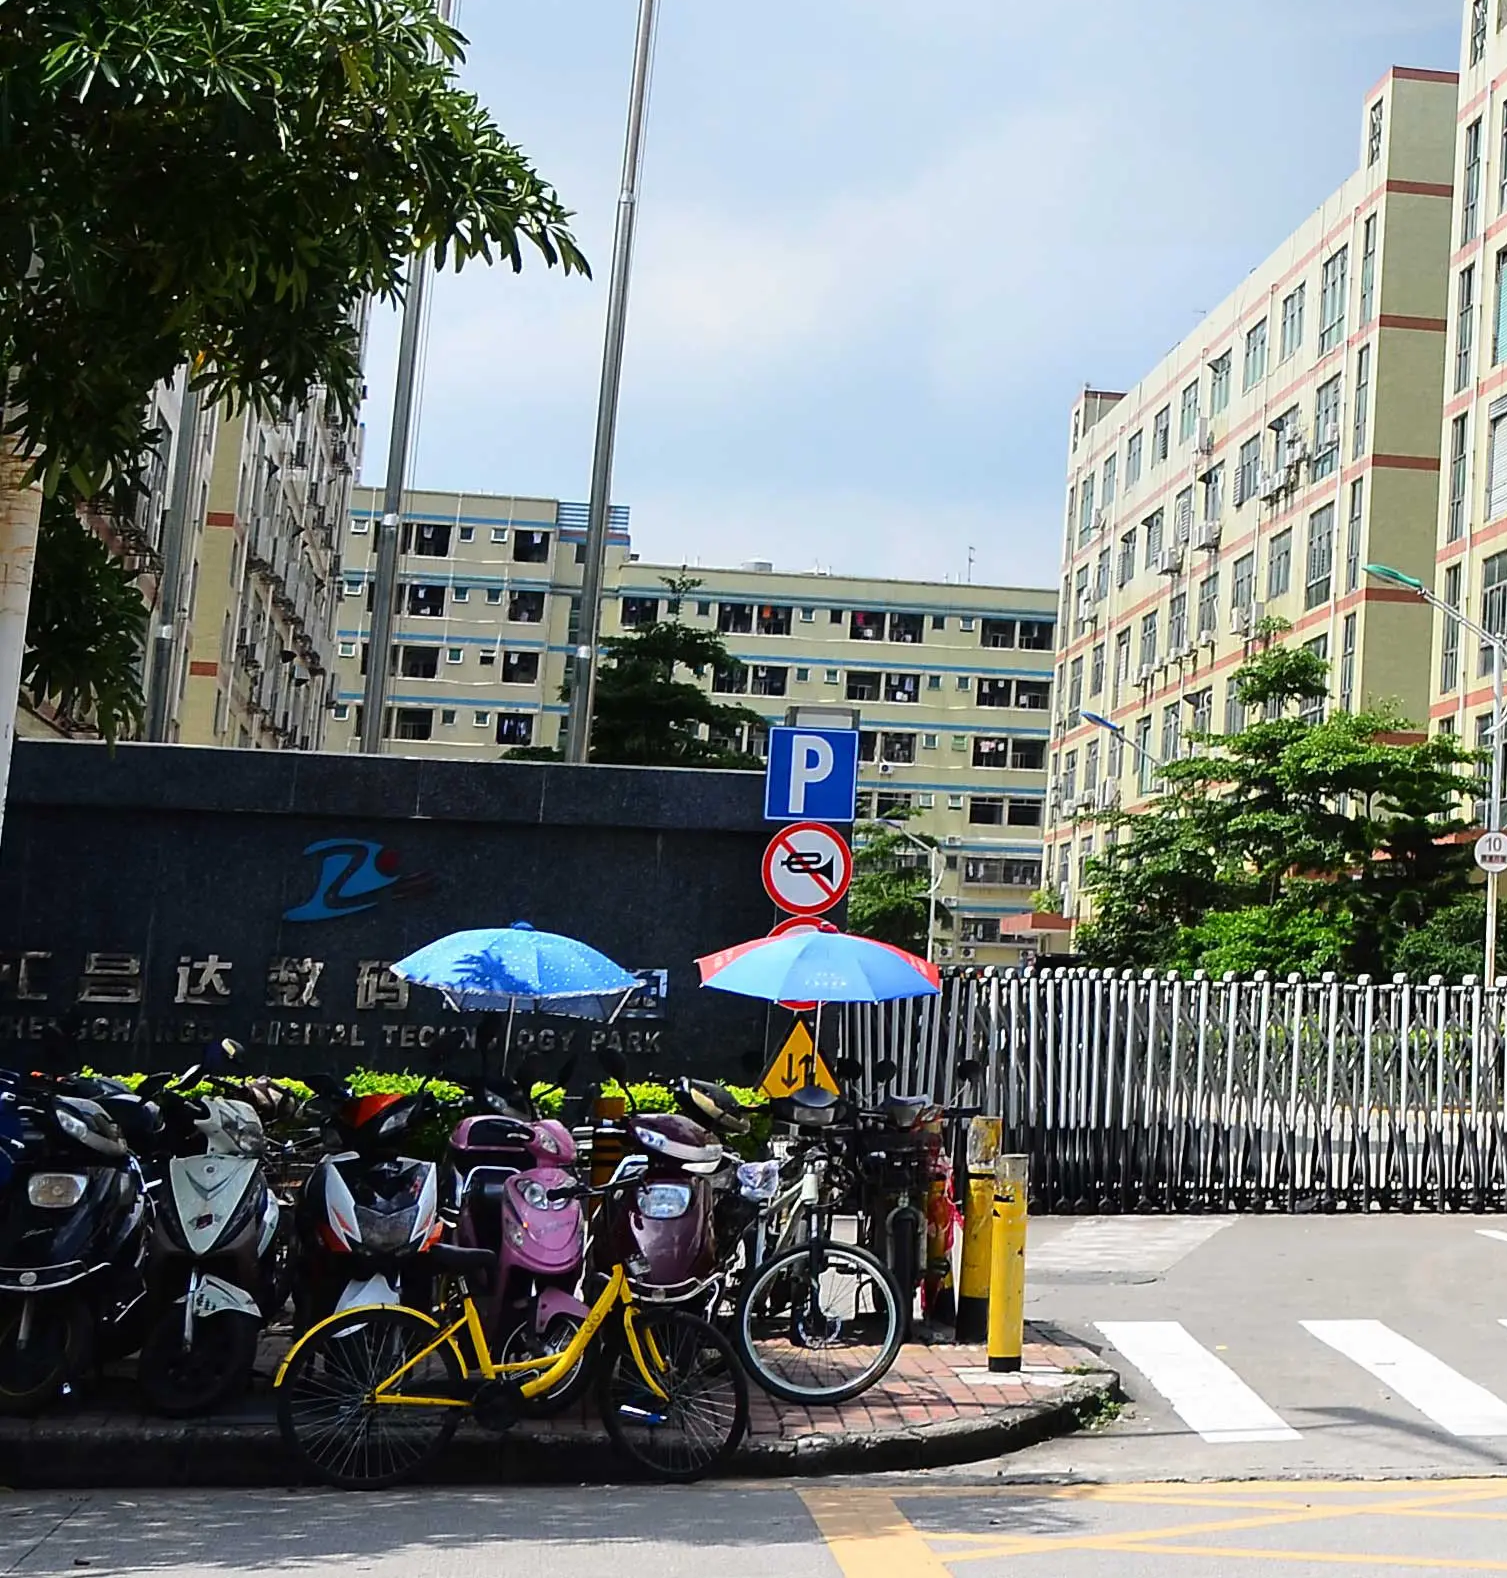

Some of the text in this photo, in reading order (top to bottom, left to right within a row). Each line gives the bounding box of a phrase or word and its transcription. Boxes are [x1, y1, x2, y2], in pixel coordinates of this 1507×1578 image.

[787, 734, 834, 814] P
[1485, 837, 1502, 852] 10
[590, 1029, 663, 1054] PARK
